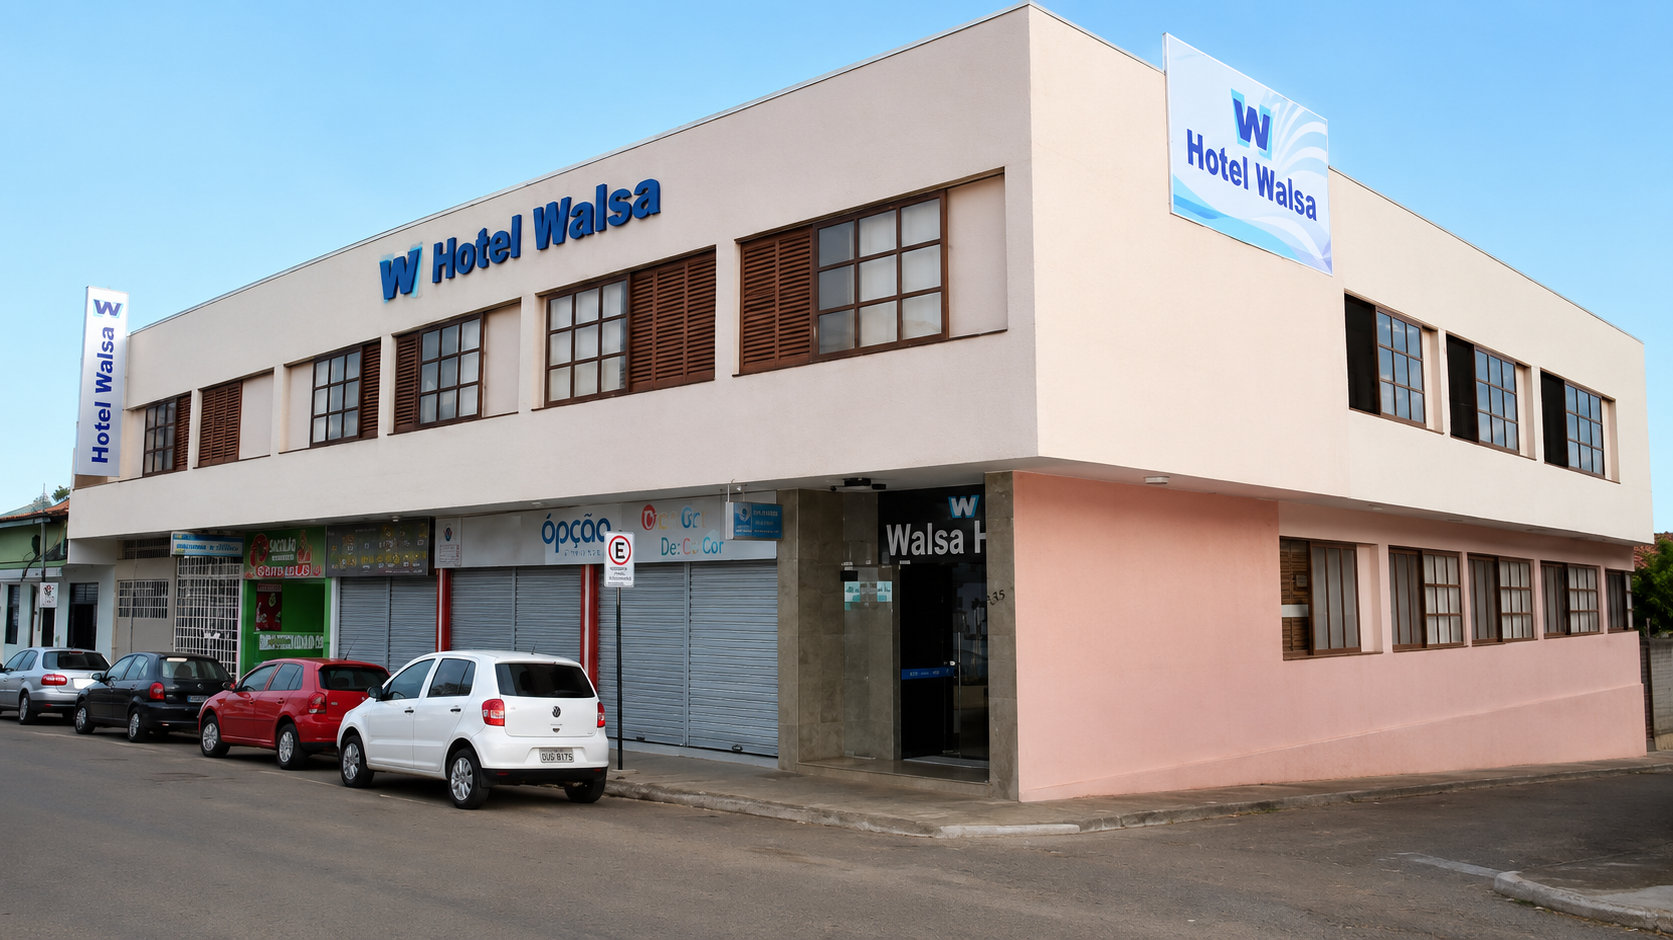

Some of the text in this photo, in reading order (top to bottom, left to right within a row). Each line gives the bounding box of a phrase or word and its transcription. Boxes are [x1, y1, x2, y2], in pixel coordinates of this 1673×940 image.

[1186, 128, 1318, 222] Hotel Walsa
[432, 214, 523, 284] Hotel
[533, 178, 661, 250] Walsa
[91, 326, 115, 464] Hotel Walsa
[615, 541, 626, 559] E
[886, 522, 965, 556] Walsa
